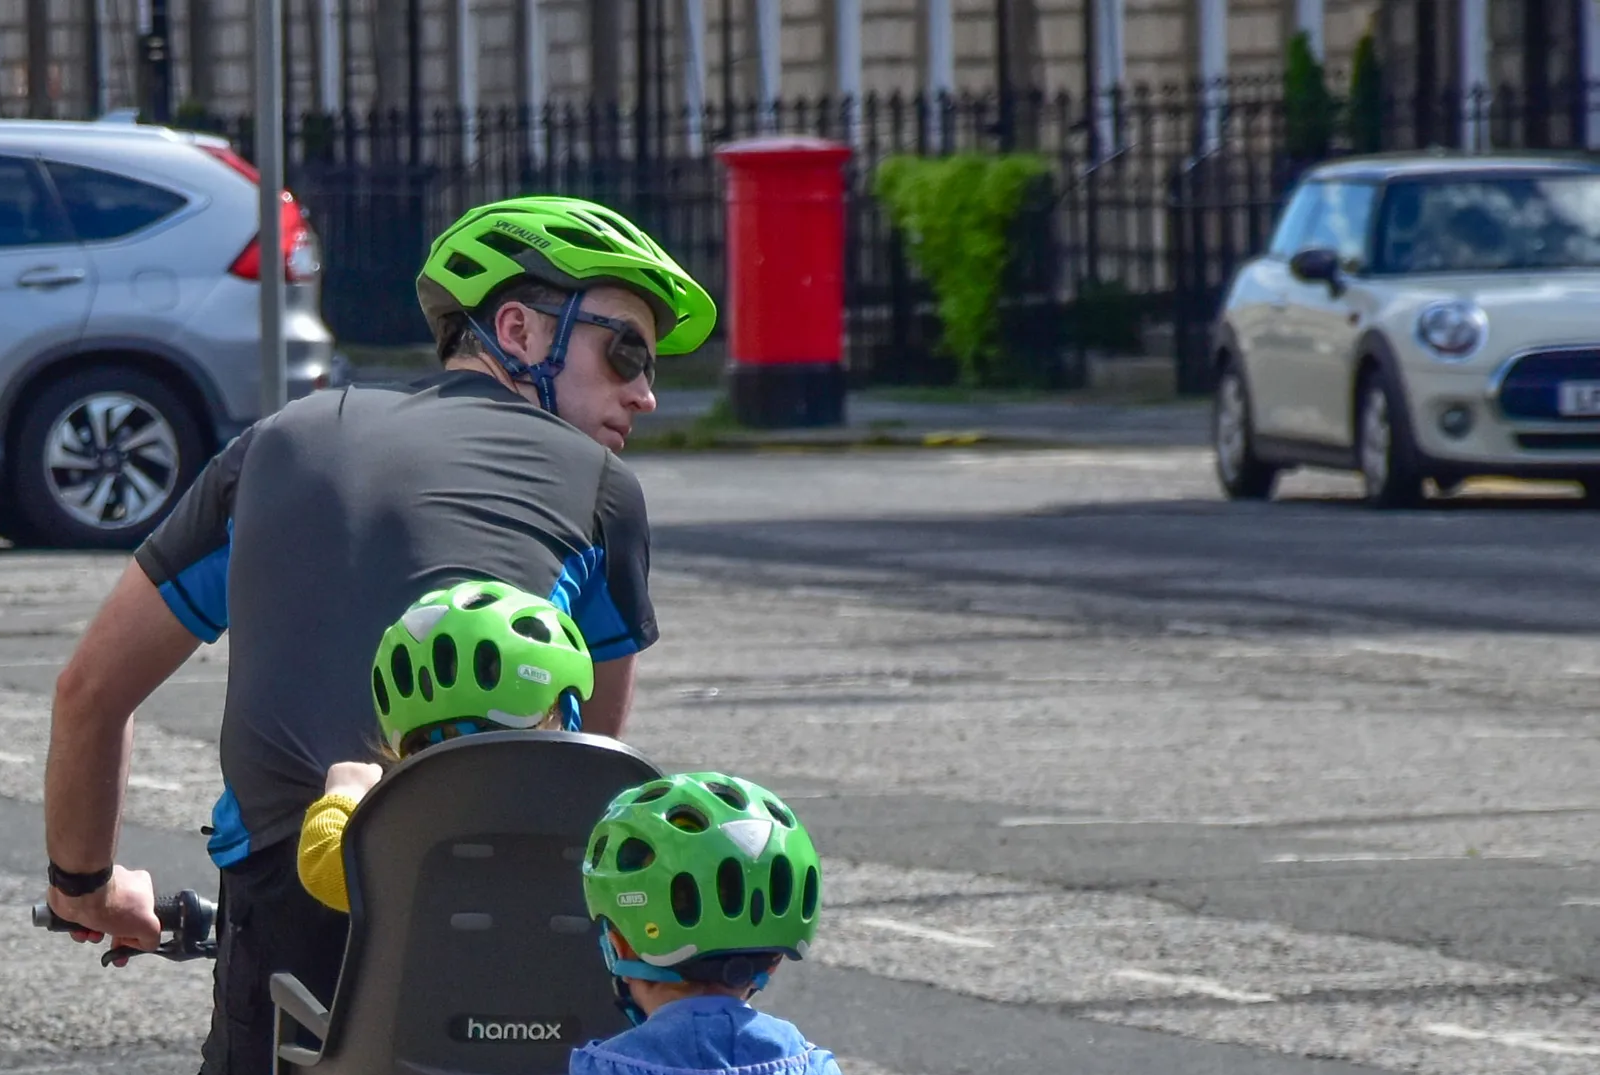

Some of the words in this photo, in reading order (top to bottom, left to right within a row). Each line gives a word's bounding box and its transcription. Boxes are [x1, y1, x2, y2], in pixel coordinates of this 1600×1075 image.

[495, 219, 551, 248] SPECIALIZED
[522, 668, 548, 681] ABUS
[620, 894, 643, 904] ABUS
[467, 1018, 561, 1040] hamax
